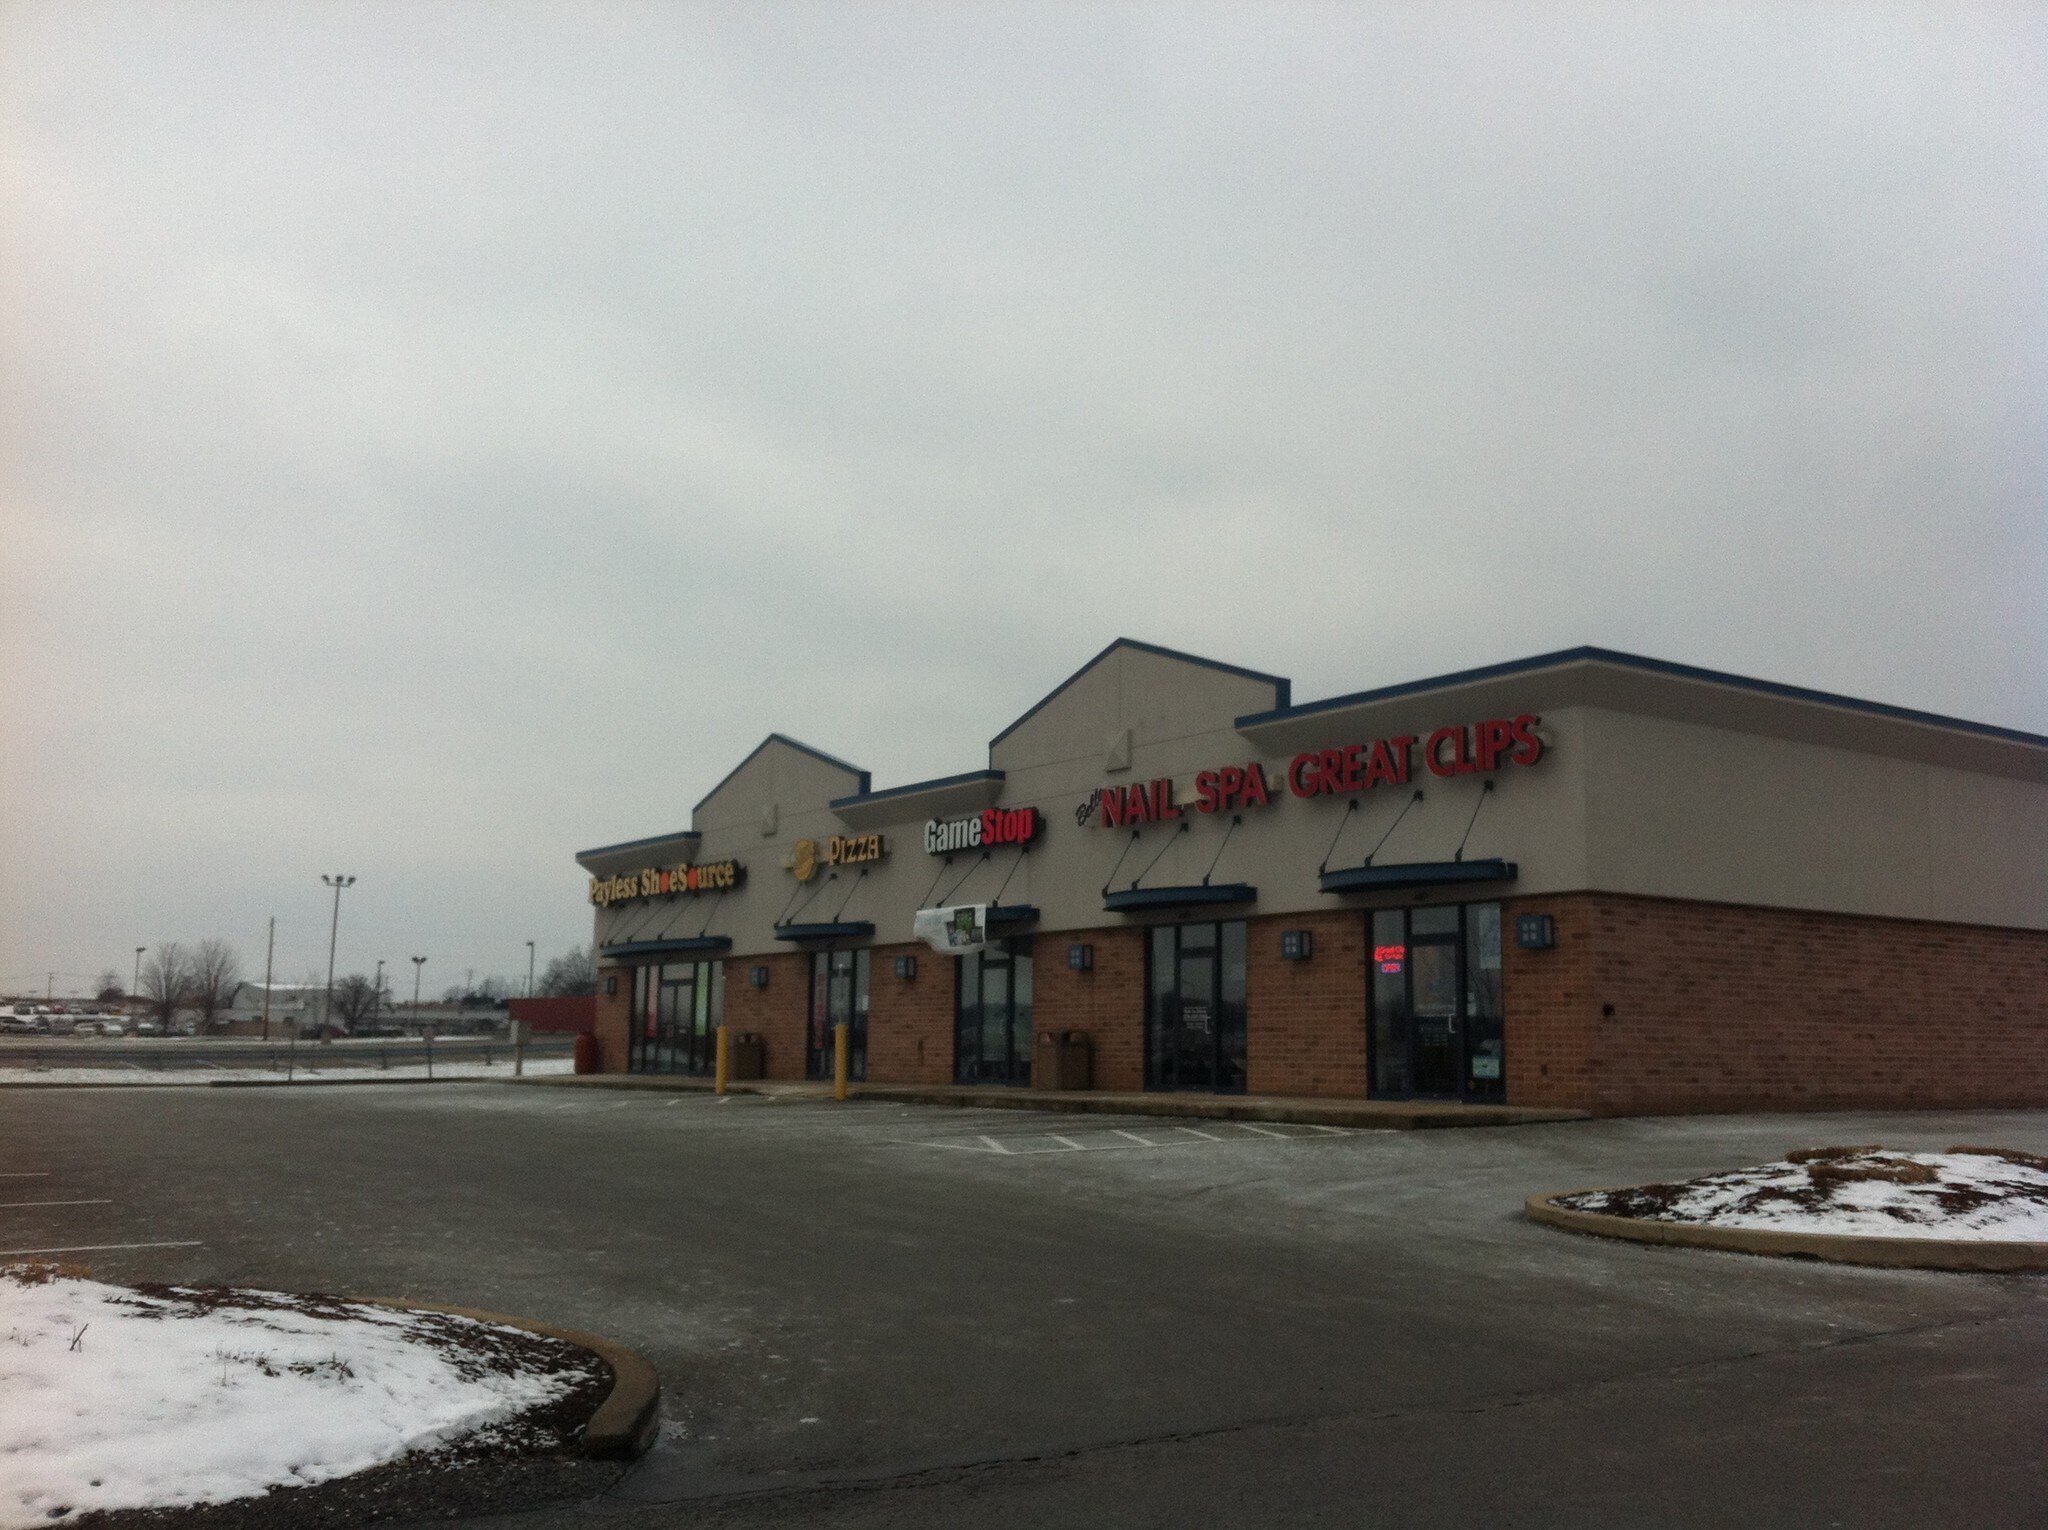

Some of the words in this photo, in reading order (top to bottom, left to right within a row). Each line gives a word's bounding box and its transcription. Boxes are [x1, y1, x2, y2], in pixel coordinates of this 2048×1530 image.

[1288, 735, 1414, 799] GREAT
[1425, 713, 1542, 778] CLIPS
[1101, 778, 1180, 828] NAIL
[1195, 762, 1268, 814] SPA
[828, 834, 882, 867] PIZZA
[923, 808, 1036, 855] GameStop
[588, 873, 639, 908] Payless
[640, 859, 737, 897] ShoeSource
